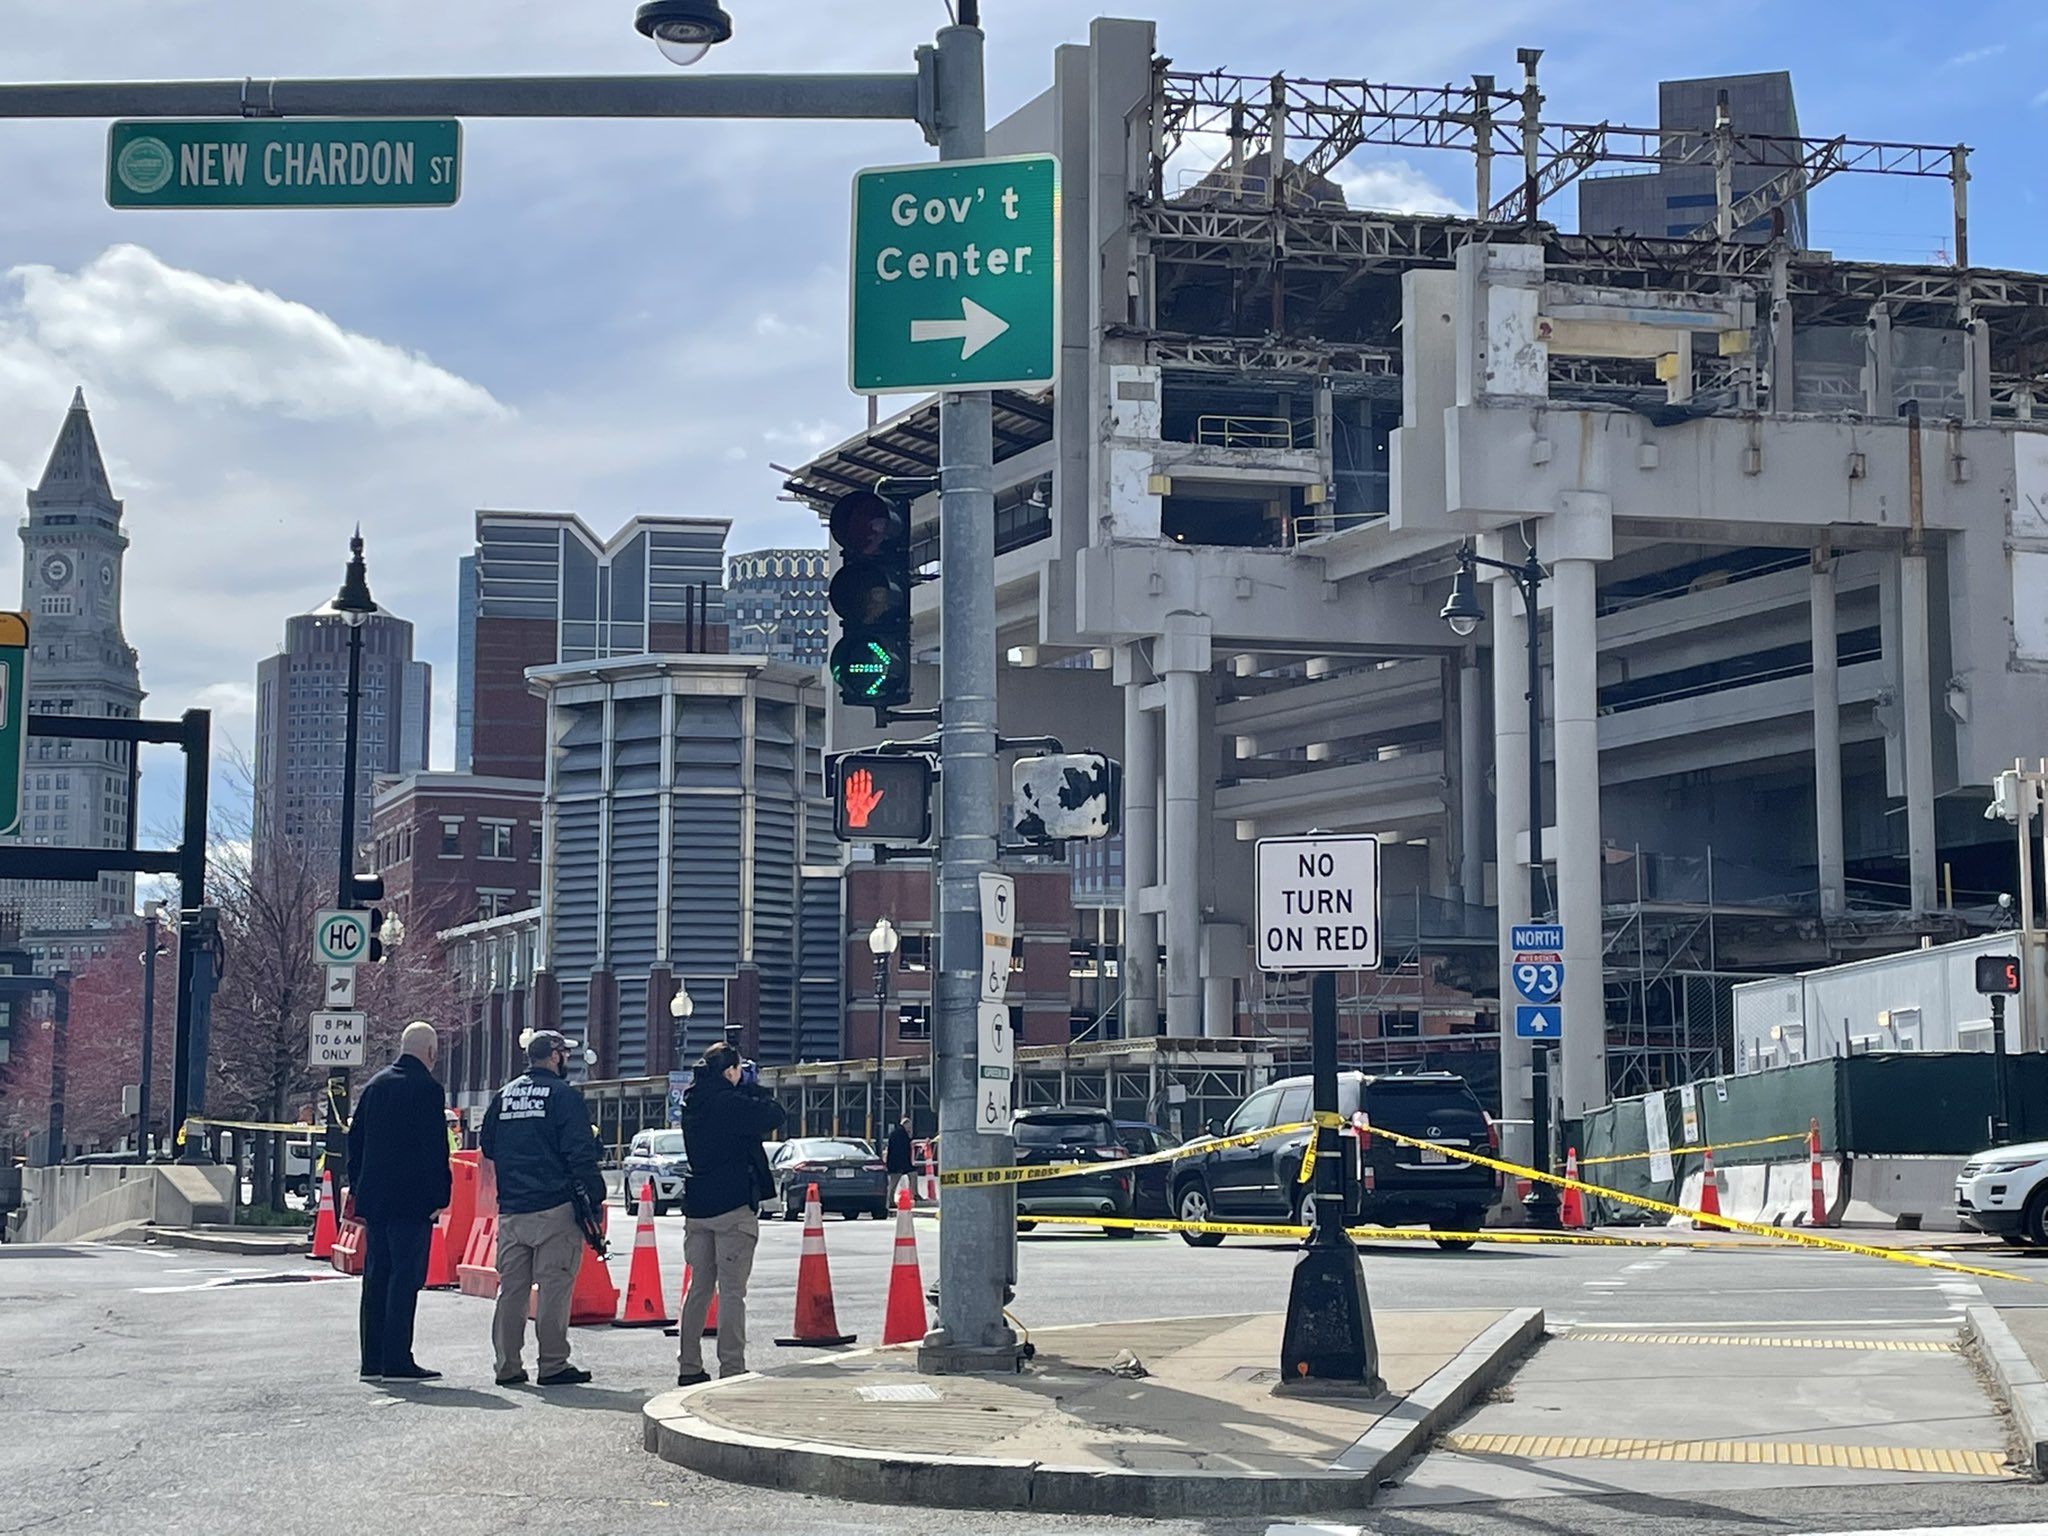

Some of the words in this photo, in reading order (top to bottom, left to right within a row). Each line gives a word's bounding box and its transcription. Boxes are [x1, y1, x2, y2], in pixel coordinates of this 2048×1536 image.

[180, 143, 247, 187] NEW
[264, 141, 415, 187] CHARDON
[430, 156, 453, 184] ST
[876, 243, 1032, 281] Center
[1299, 853, 1334, 878] NO
[1281, 889, 1352, 914] TURN
[329, 924, 357, 951] HC
[1267, 926, 1302, 952] ON
[1315, 926, 1368, 951] RED
[1516, 930, 1560, 946] NORTH
[1518, 965, 1558, 995] 93
[2006, 964, 2017, 989] 5
[325, 1020, 332, 1030] 8
[336, 1020, 352, 1030] PM
[315, 1034, 328, 1045] TO
[334, 1035, 342, 1045] 6
[344, 1034, 361, 1045] AM
[322, 1049, 352, 1060] ONLY
[501, 1084, 551, 1098] Boston
[502, 1097, 545, 1112] Police
[964, 1172, 983, 1183] LINE
[987, 1171, 1001, 1182] DO
[1005, 1169, 1024, 1181] NOT
[1027, 1168, 1060, 1178] CROSS
